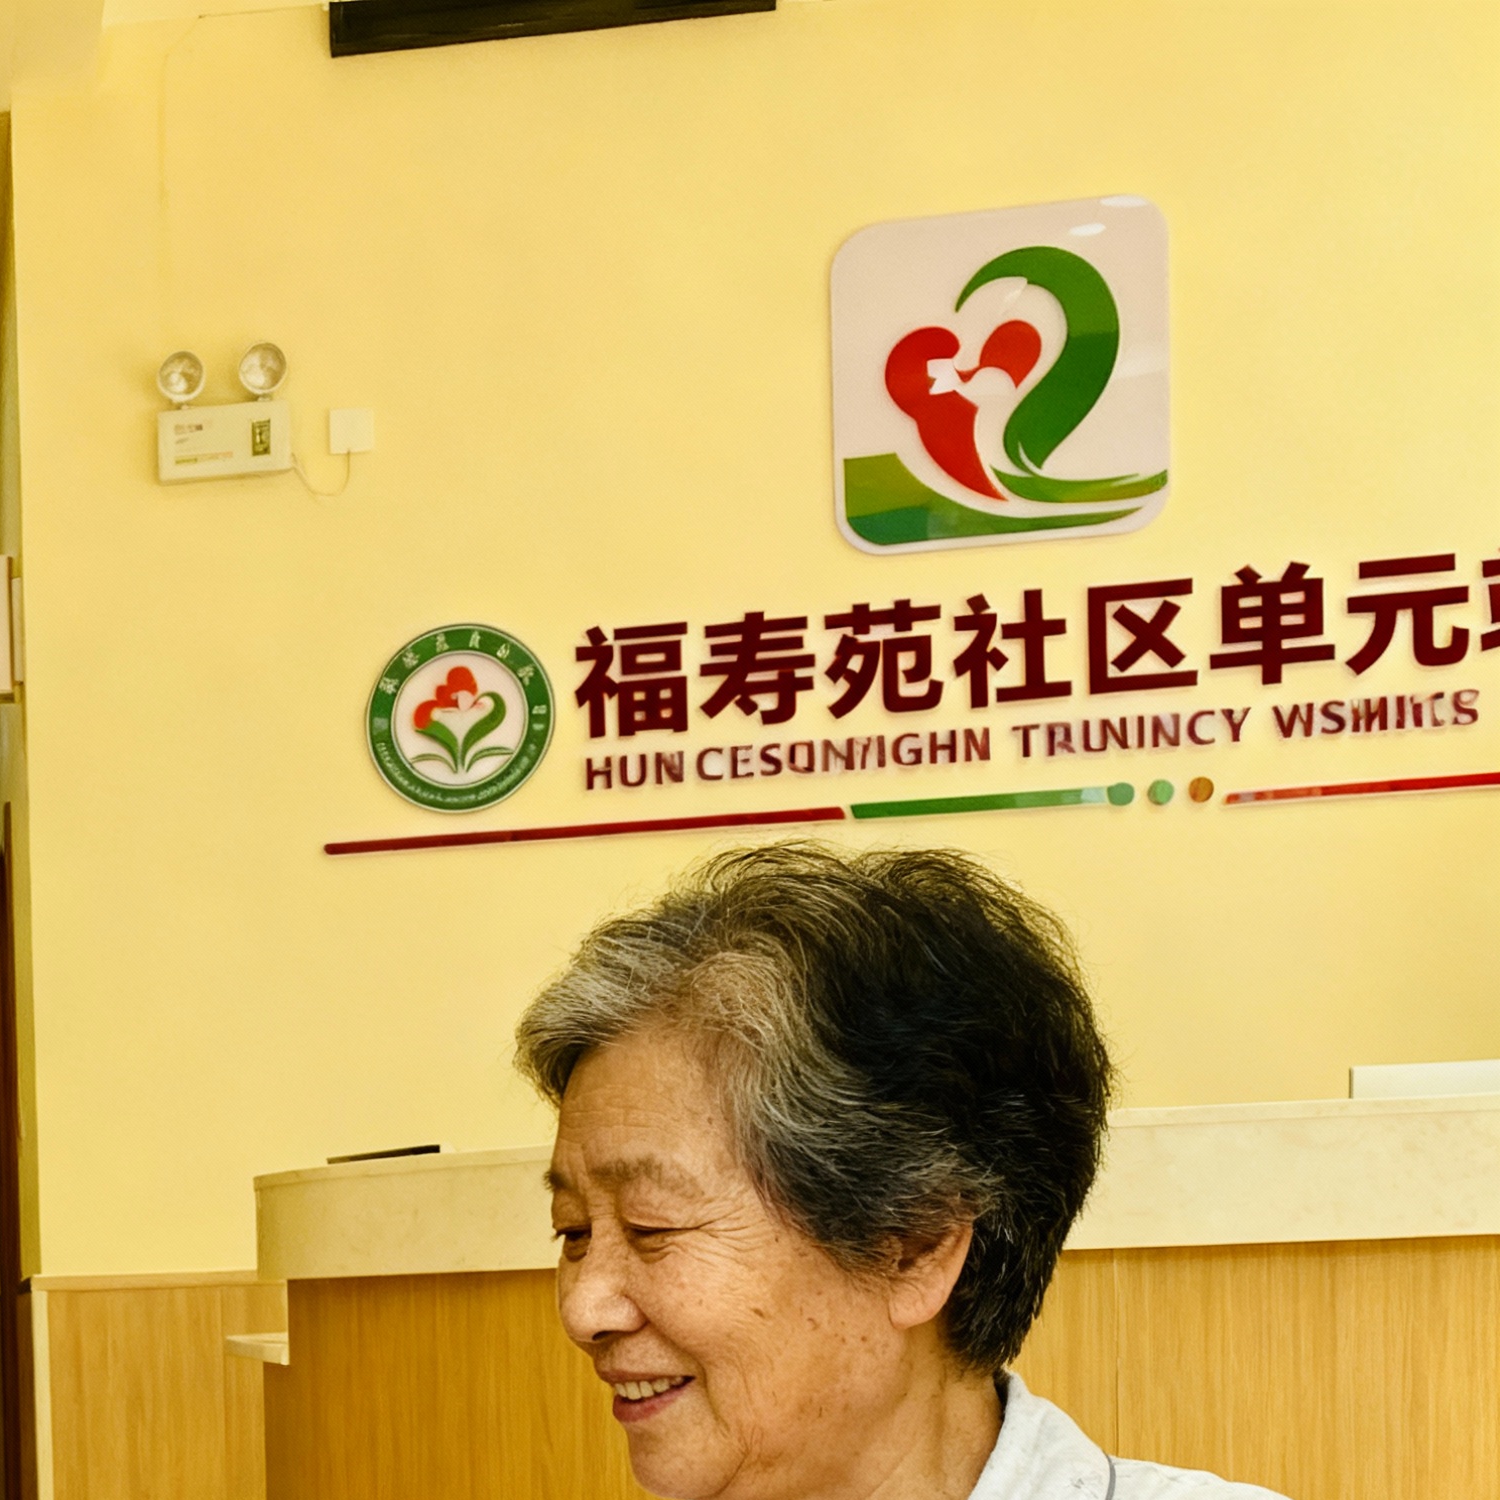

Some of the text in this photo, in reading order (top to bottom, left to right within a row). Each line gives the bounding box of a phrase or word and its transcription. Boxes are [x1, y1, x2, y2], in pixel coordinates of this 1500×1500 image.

[574, 547, 1500, 739] 福寿苑社区单元
